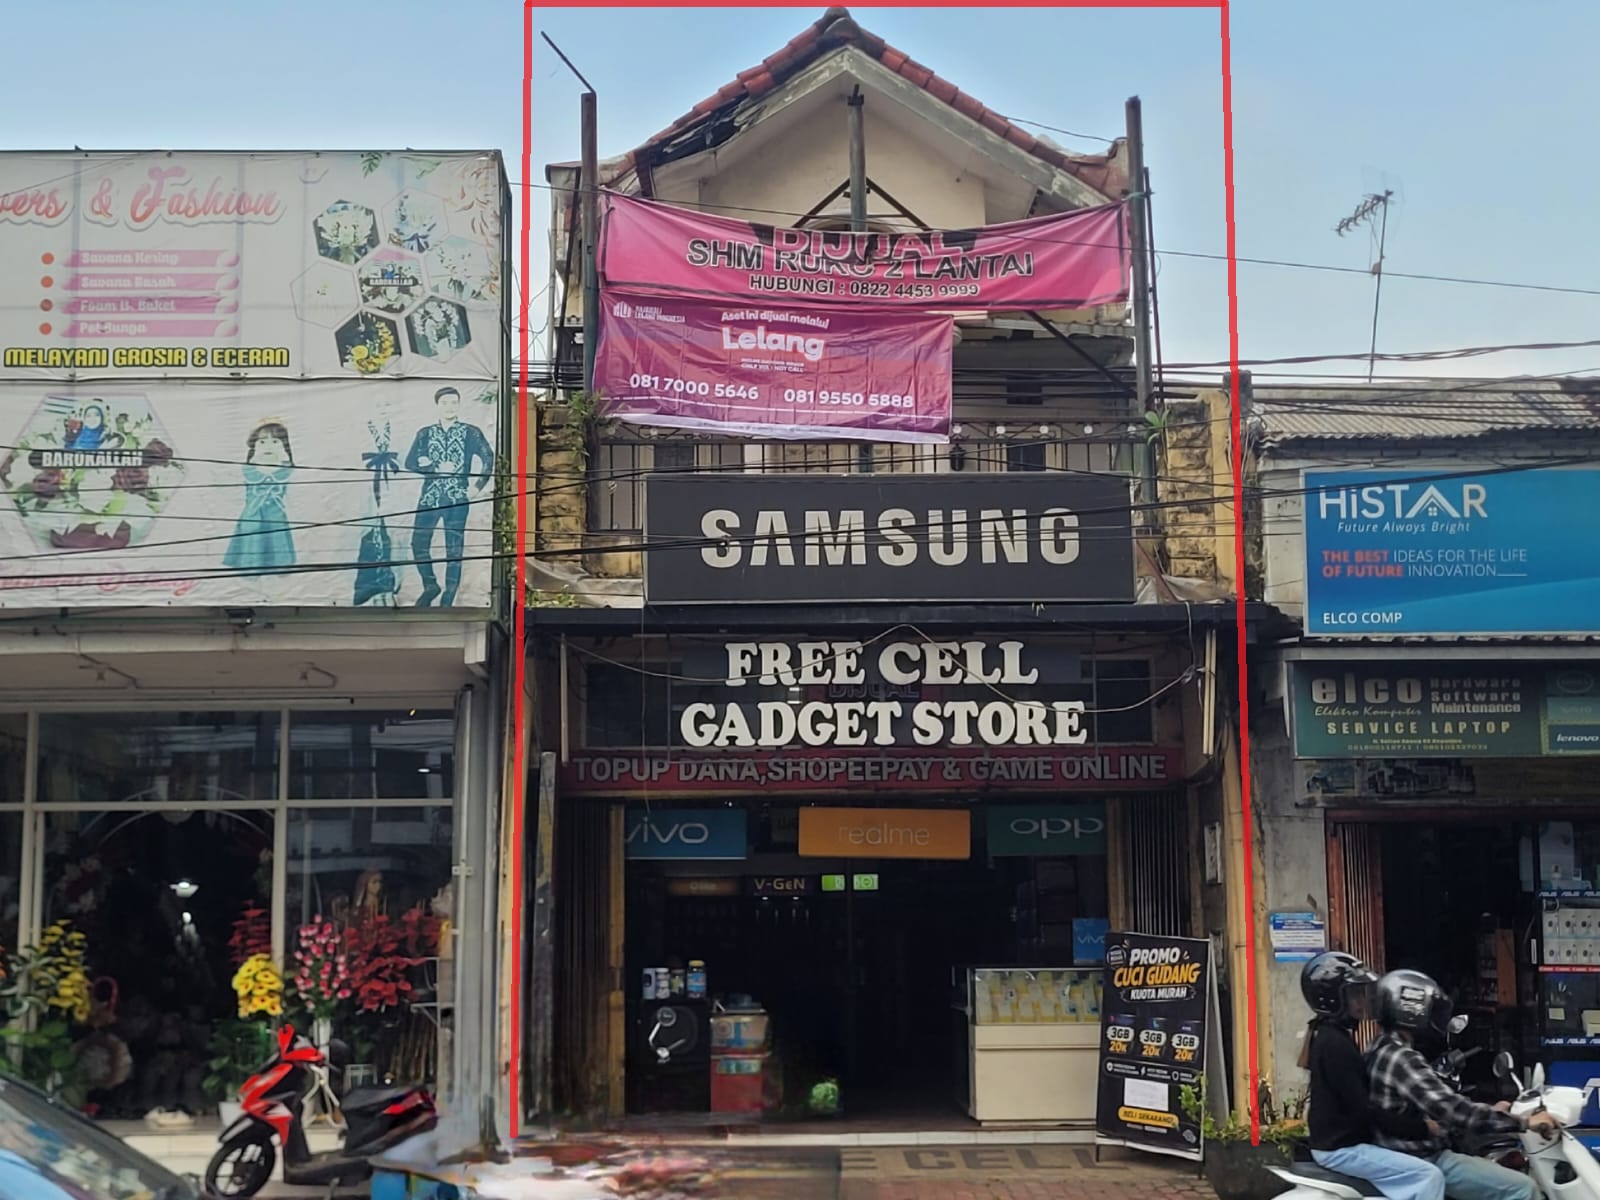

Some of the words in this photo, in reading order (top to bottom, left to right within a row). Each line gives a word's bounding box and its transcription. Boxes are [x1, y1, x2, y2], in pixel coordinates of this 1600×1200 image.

[90, 177, 114, 218] &
[130, 166, 280, 223] Fashion
[772, 227, 965, 262] DIJUAL
[686, 238, 764, 271] SHM
[885, 259, 904, 279] 2
[914, 251, 1034, 279] LANTAI
[749, 275, 835, 294] HUBUNGI
[850, 280, 889, 297] 0822
[895, 281, 934, 298] 4453
[939, 283, 980, 297] 9999
[721, 311, 745, 322] Aset
[746, 310, 759, 321] ini
[760, 311, 789, 323] dijual
[790, 315, 830, 330] melalui
[722, 326, 825, 361] Lelang
[4, 348, 109, 368] MELAYANI
[113, 348, 188, 368] GROSIR
[192, 348, 208, 367] &
[212, 348, 290, 368] ECERAN
[629, 373, 658, 390] 081
[663, 376, 709, 396] 7000
[714, 384, 759, 400] 5646
[784, 387, 814, 404] 081
[819, 390, 864, 407] 9550
[868, 393, 914, 409] 5888
[700, 506, 1081, 568] SAMSUNG
[1337, 521, 1378, 533] Future
[1383, 521, 1426, 536] Always
[1431, 520, 1470, 535] Bright
[1321, 549, 1351, 563] THE
[1354, 549, 1389, 563] BEST
[1393, 549, 1433, 563] IDEAS
[1437, 549, 1465, 563] FOR
[1469, 549, 1496, 563] THE
[1500, 549, 1527, 563] LIFE
[1321, 565, 1342, 578] OF
[1347, 565, 1403, 578] FUTURE
[1408, 564, 1496, 578] INNOVATION
[1323, 612, 1358, 625] ELCO
[1362, 612, 1403, 625] COMP
[725, 641, 866, 687] FREE
[878, 641, 1039, 686] CELL
[1311, 673, 1423, 705] elco
[1430, 677, 1521, 689] Hardware
[1431, 690, 1521, 702] Software
[1315, 705, 1360, 717] Elektro
[1363, 705, 1422, 718] Komputer
[1431, 703, 1521, 714] Maintenance
[680, 701, 903, 747] GADGET
[911, 701, 1088, 746] STORE
[1327, 721, 1418, 735] SERVICE
[1431, 721, 1512, 735] LAPTOP
[1556, 732, 1599, 742] lenovo
[573, 757, 673, 782] TOPUP
[942, 756, 962, 780] &
[969, 756, 1053, 780] GAME
[1061, 755, 1167, 780] ONLINE
[838, 823, 931, 847] realme
[1129, 947, 1181, 966] PROMO
[1113, 966, 1144, 988] CUCI
[1146, 963, 1201, 986] GUDANG
[1130, 988, 1156, 1000] KUOTA
[1157, 986, 1188, 999] MURAH
[1110, 1027, 1131, 1039] 3GB
[1143, 1031, 1163, 1044] 3GB
[1175, 1035, 1196, 1048] 3GB
[904, 1148, 1130, 1171] CELL
